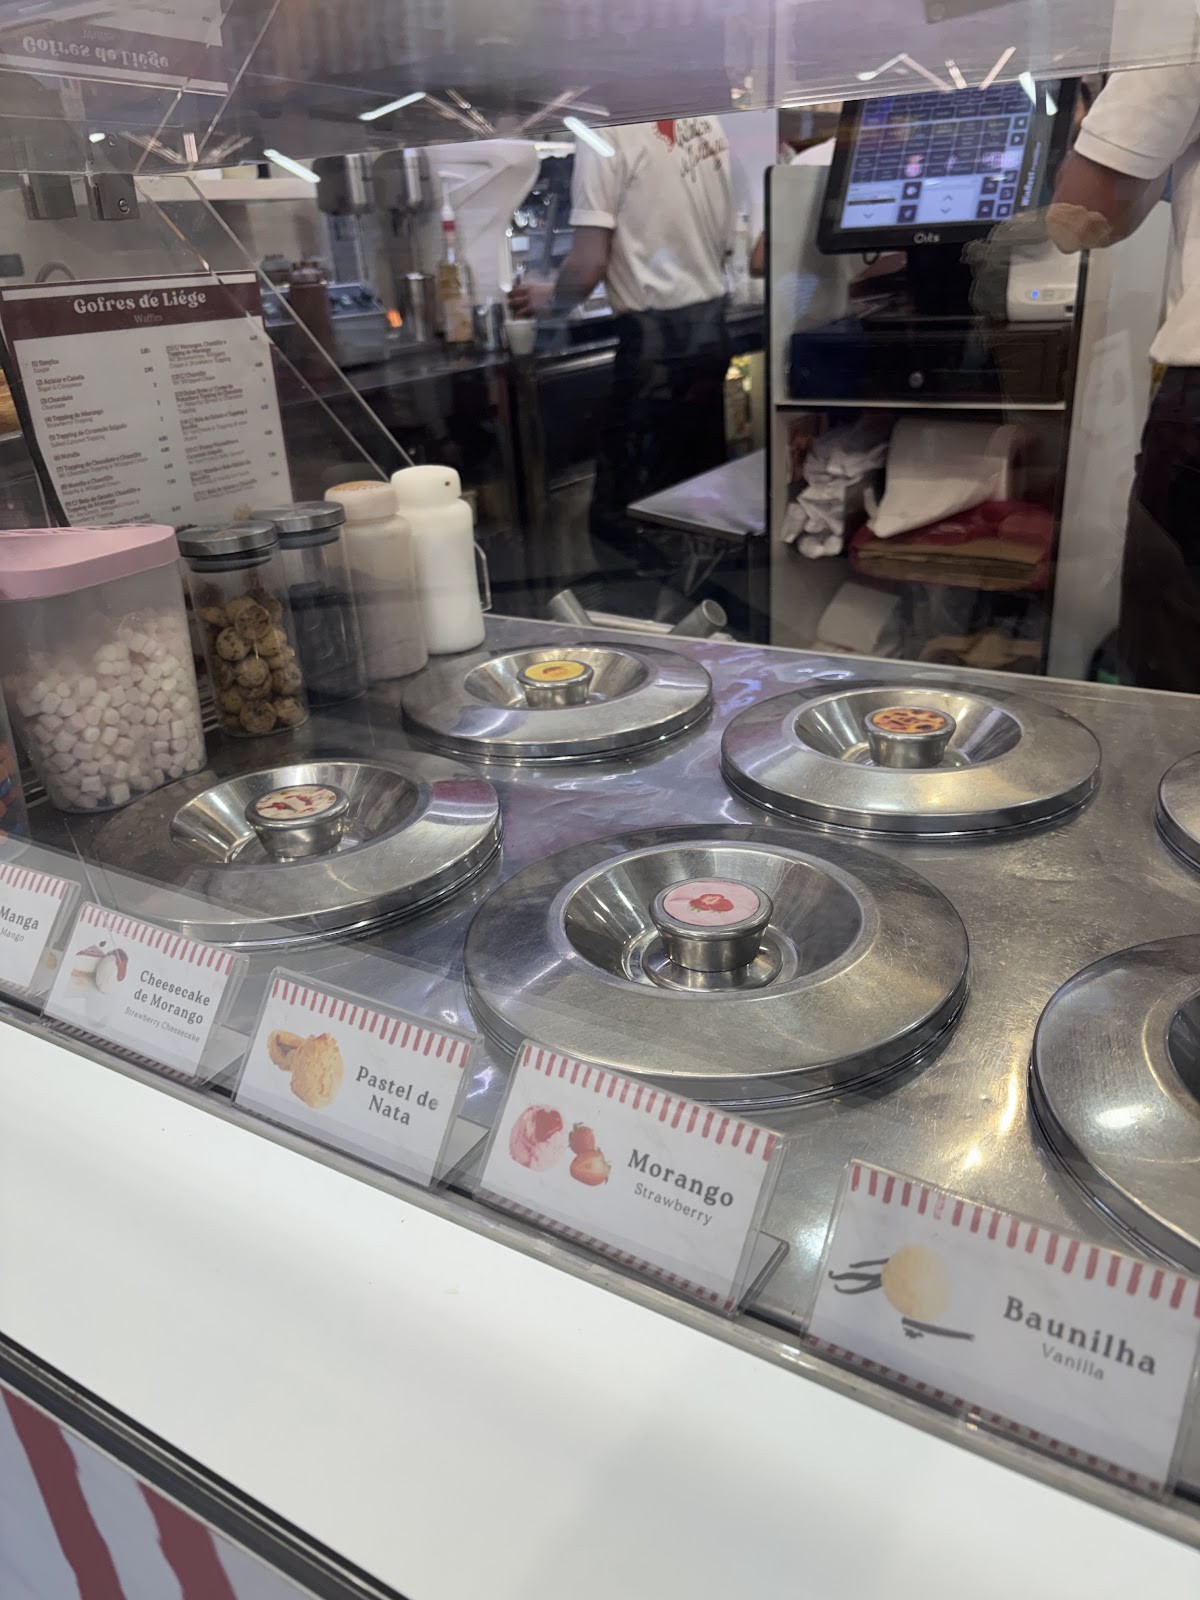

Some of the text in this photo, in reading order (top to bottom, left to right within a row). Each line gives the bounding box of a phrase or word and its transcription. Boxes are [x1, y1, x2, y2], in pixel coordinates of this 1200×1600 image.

[73, 290, 207, 314] Gofres de Liége
[0, 905, 39, 931] Manga
[1, 927, 25, 943] Mango
[140, 970, 210, 1006] Cheesecake
[125, 1006, 200, 1043] Strawberry Cheesecake
[134, 989, 204, 1025] de Morango
[356, 1065, 438, 1111] Pastel de
[368, 1094, 410, 1125] Nata
[628, 1148, 733, 1207] Morango
[634, 1182, 712, 1226] Strawberry
[1003, 1295, 1156, 1376] Baunilha
[1042, 1342, 1104, 1380] Vanilla
